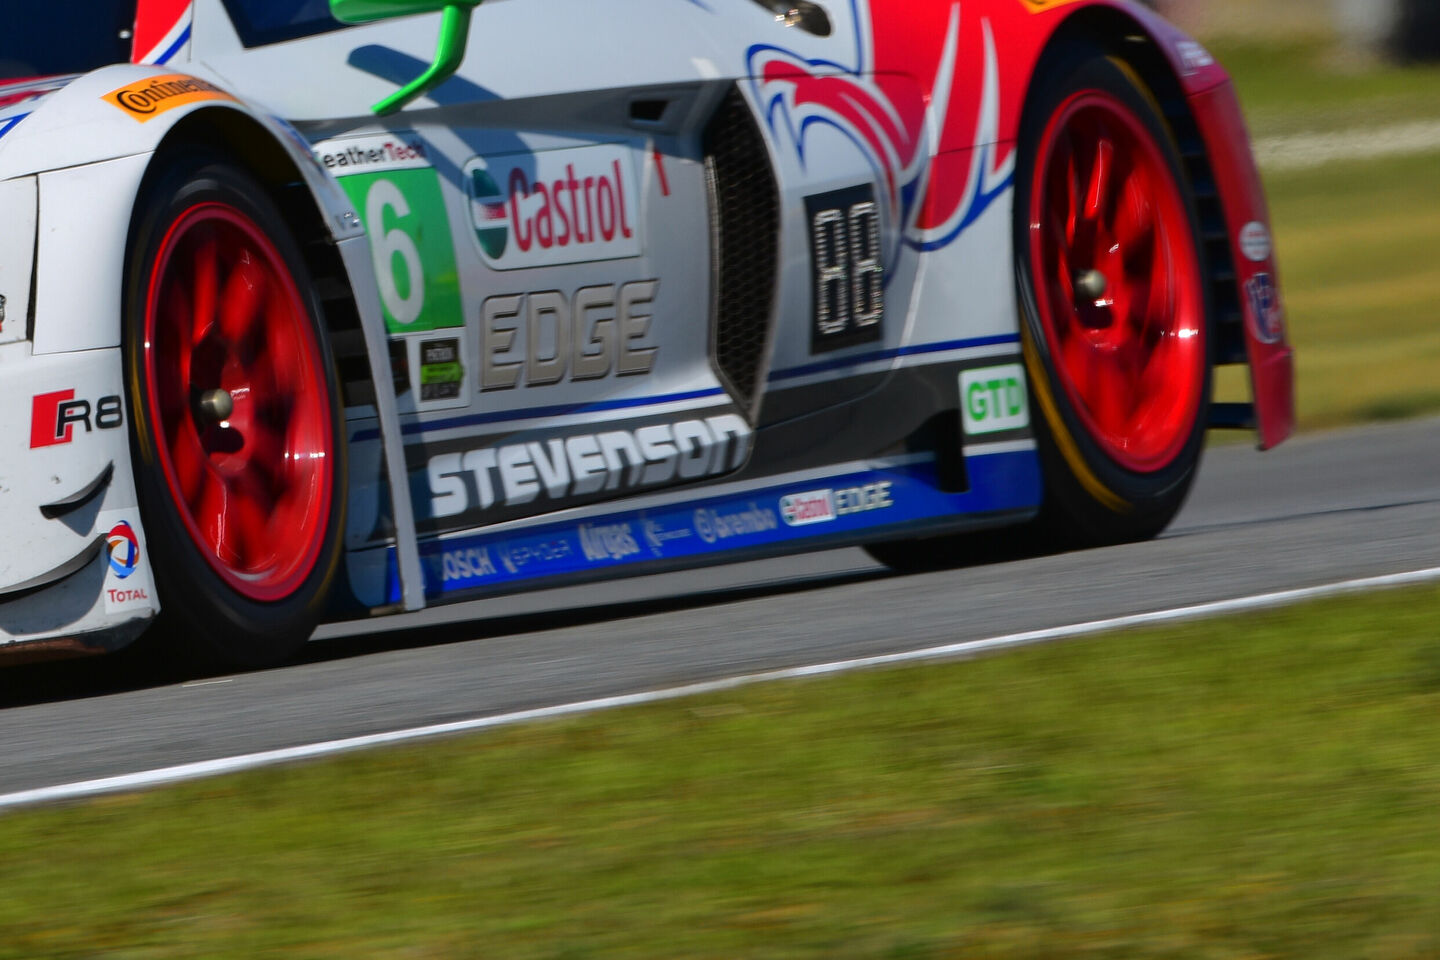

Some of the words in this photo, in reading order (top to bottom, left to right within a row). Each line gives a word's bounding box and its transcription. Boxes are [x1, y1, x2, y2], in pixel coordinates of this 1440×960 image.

[316, 142, 428, 168] eatherTech
[510, 159, 633, 253] Castrol
[365, 178, 426, 325] 6
[480, 278, 659, 393] EDGE
[56, 395, 123, 437] R8
[965, 377, 1025, 422] GTD
[427, 413, 753, 518] STEVENSON
[835, 481, 894, 515] EDGE
